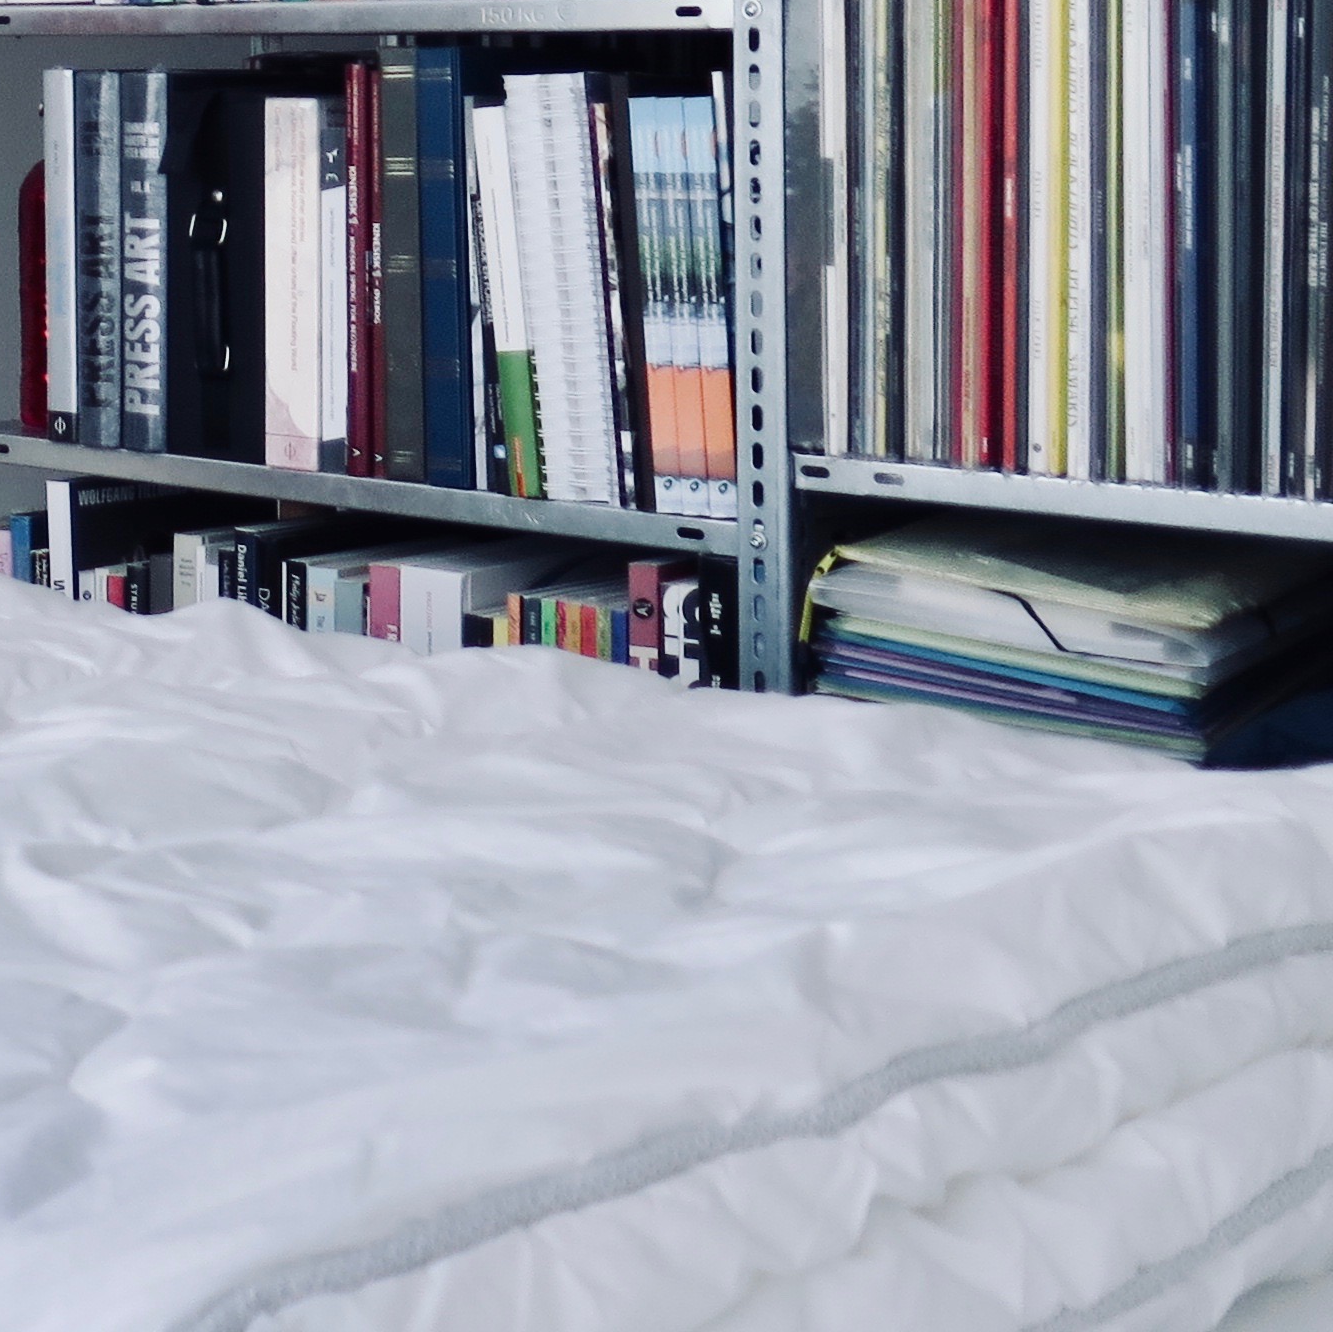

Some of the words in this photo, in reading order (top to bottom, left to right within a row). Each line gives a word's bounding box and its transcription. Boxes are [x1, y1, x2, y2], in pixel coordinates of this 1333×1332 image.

[348, 165, 358, 216] KINESISK
[83, 213, 116, 281] ART
[124, 212, 161, 286] ART
[372, 222, 382, 269] KINESISK
[1309, 224, 1318, 249] THE
[1308, 252, 1318, 287] DEAD
[83, 289, 116, 409] PRESS
[123, 293, 161, 416] PRESS
[349, 323, 358, 373] BEGYNDERE
[77, 487, 135, 506] WOLFGANG
[236, 543, 247, 583] Daniel
